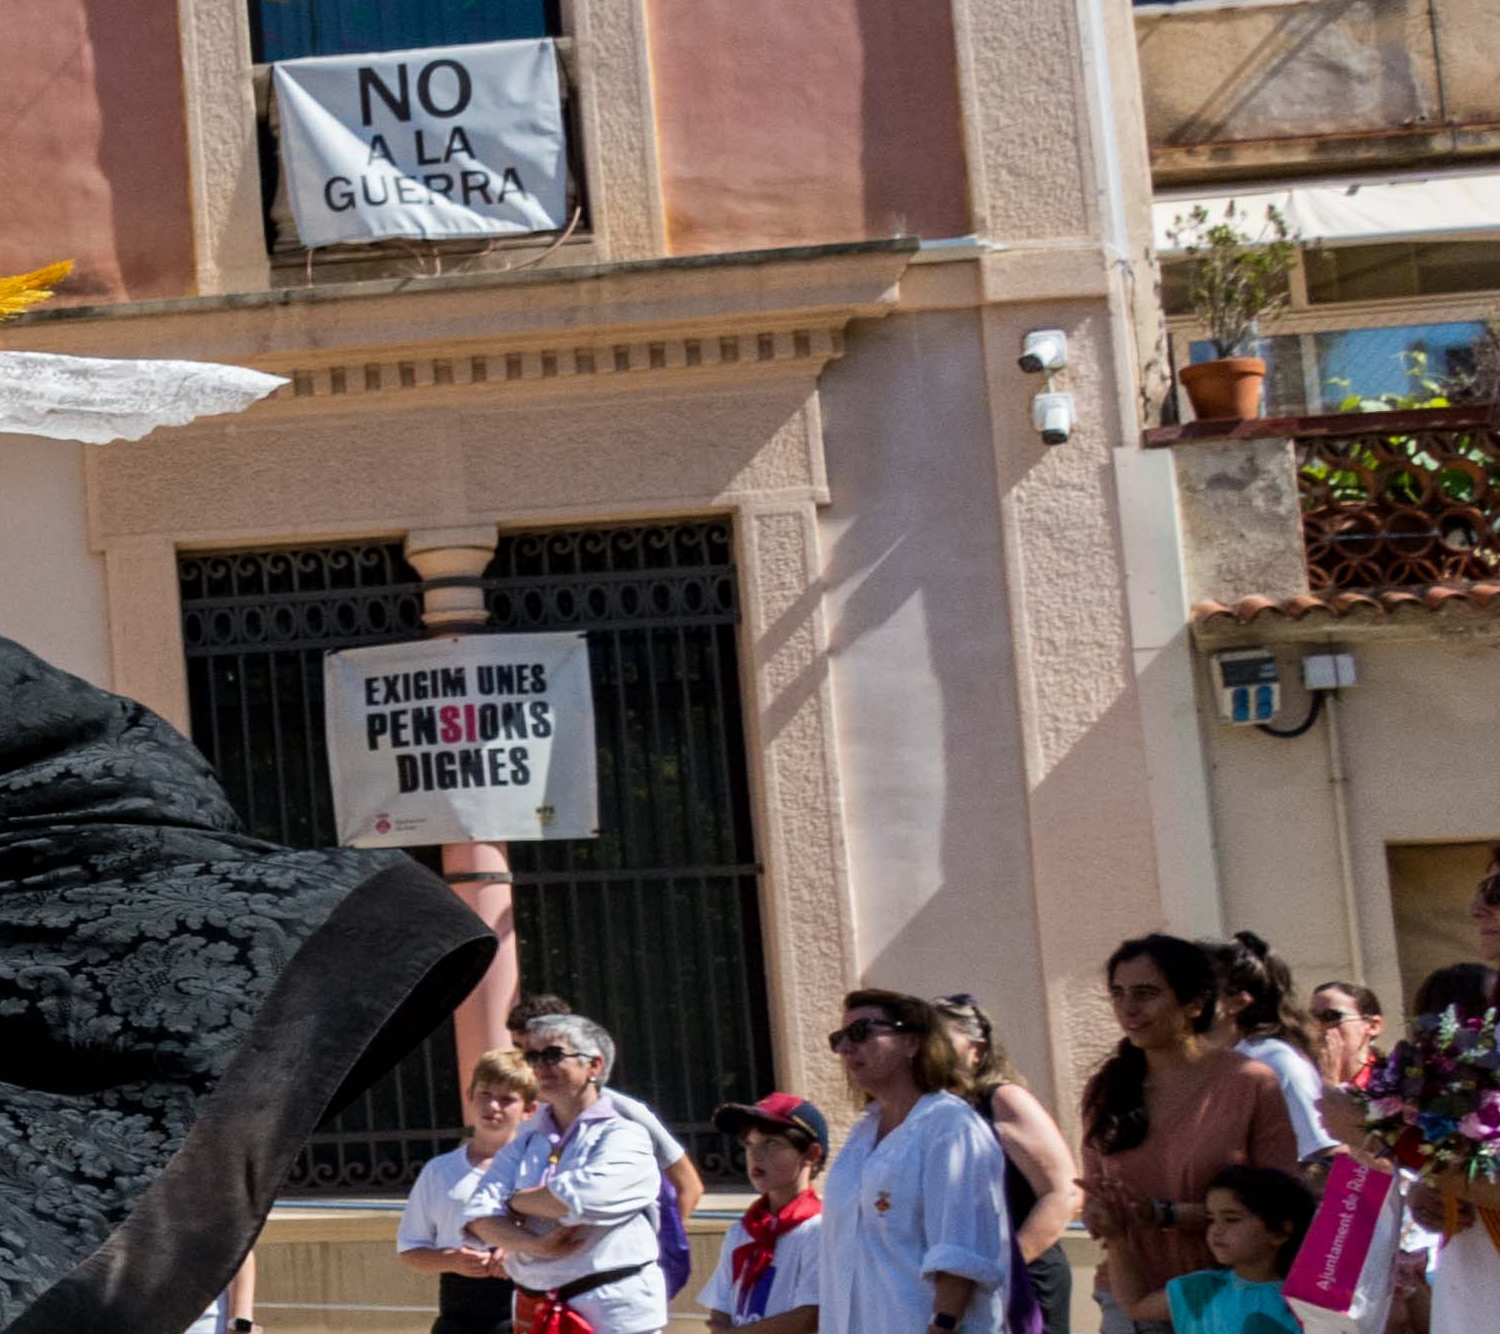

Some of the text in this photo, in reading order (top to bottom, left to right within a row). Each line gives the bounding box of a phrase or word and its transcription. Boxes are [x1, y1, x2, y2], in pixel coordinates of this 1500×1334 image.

[358, 59, 472, 127] NO
[368, 126, 476, 168] A LA
[323, 167, 529, 213] GUERRA
[364, 663, 547, 706] EXIGIM UNES
[366, 701, 552, 751] PENSIONS
[396, 746, 531, 794] DIGNES
[1315, 1164, 1370, 1292] Ajuntament de Rub
